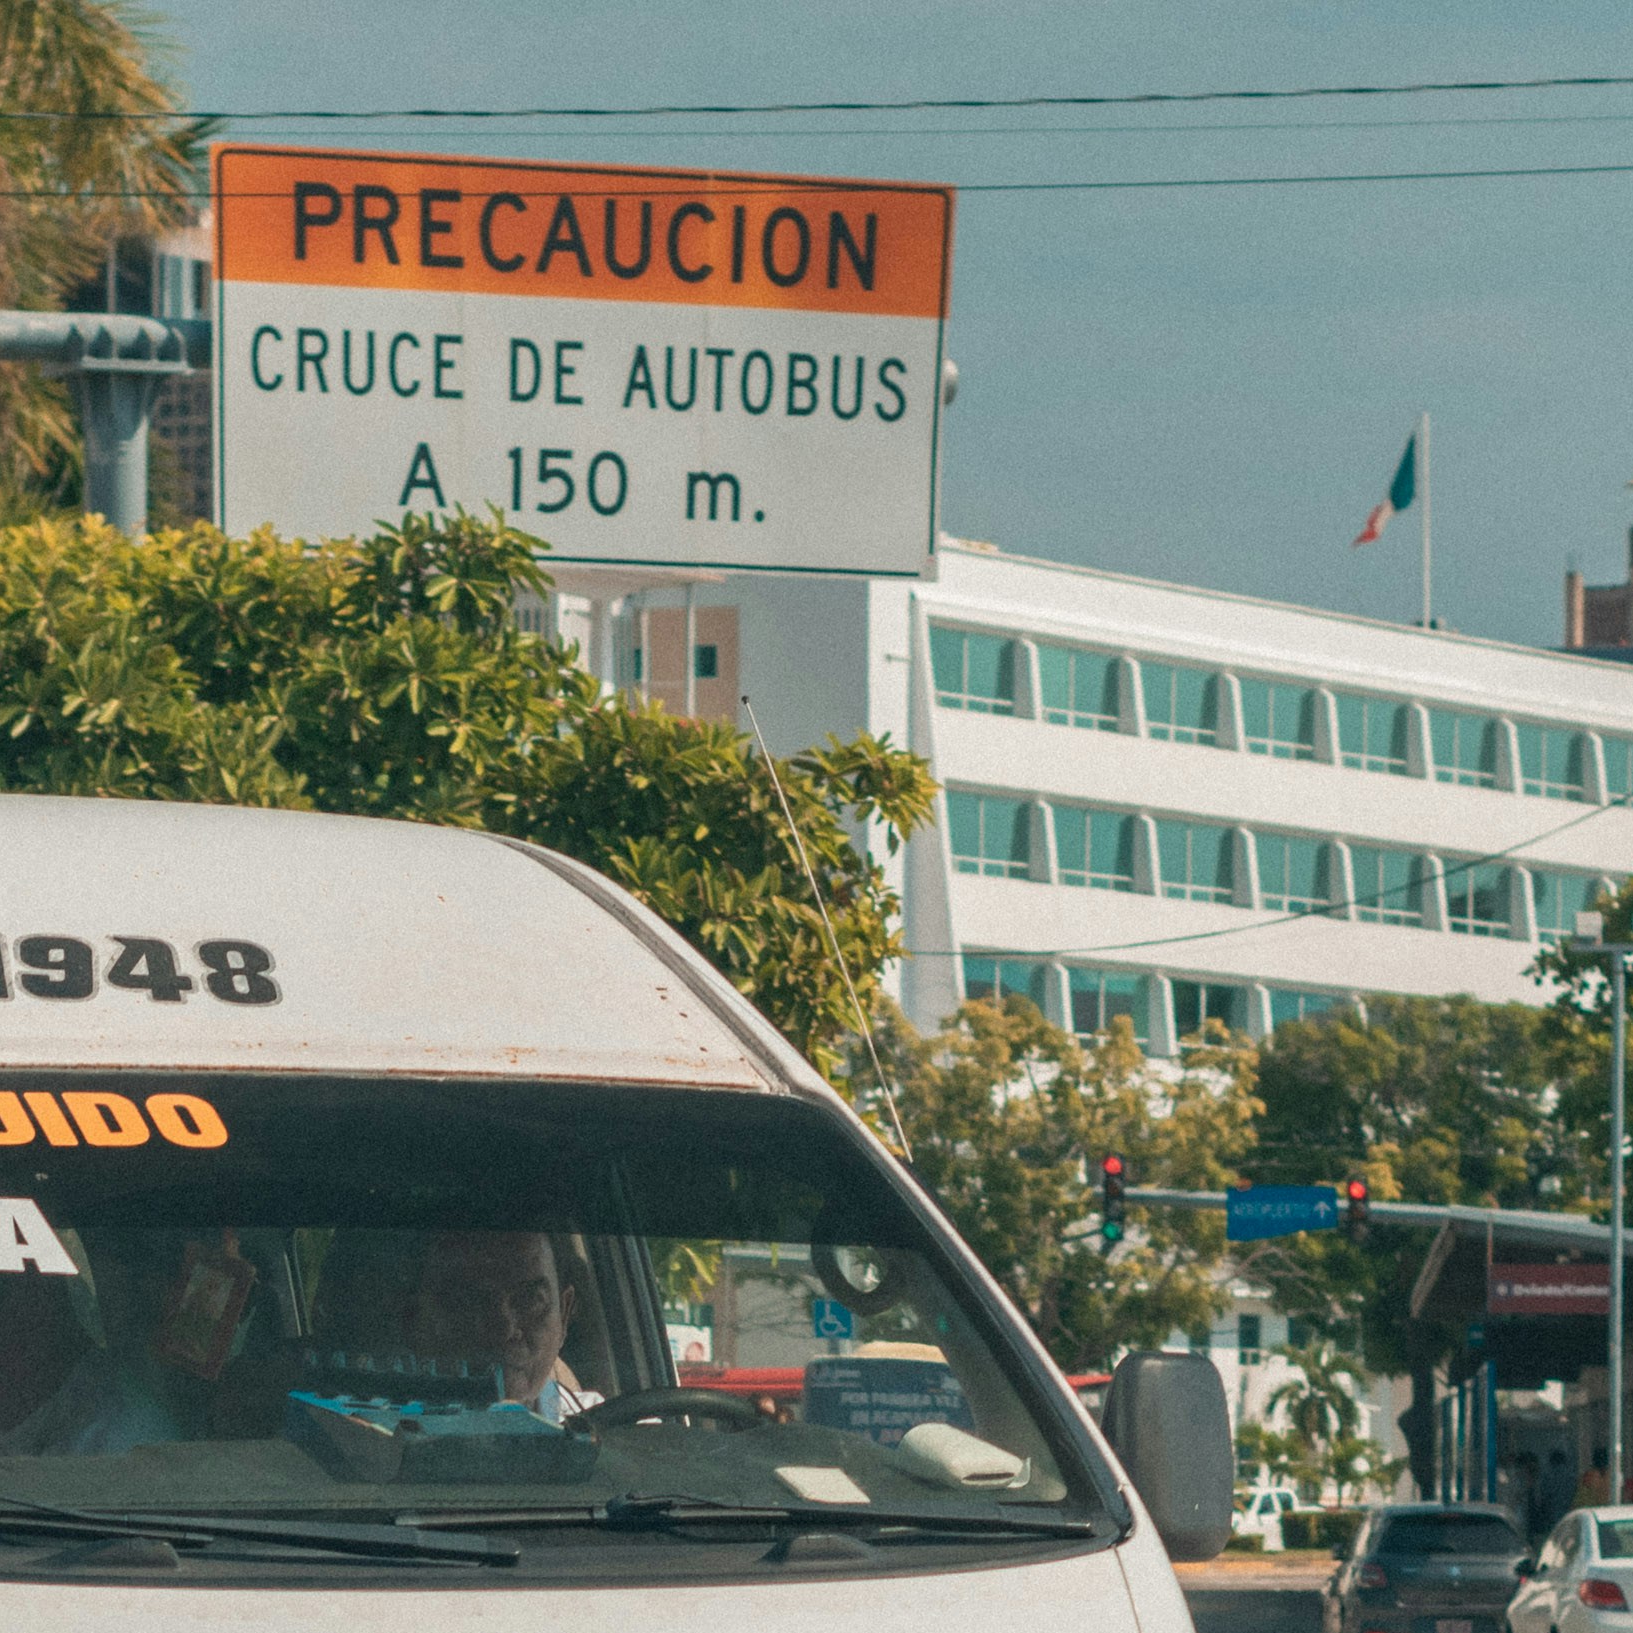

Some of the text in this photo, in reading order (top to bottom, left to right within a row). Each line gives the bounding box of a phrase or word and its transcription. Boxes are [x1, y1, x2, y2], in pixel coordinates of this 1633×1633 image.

[293, 182, 877, 291] PRECAUCION
[250, 325, 908, 422] CRUCE DE AUTOBUS
[398, 442, 767, 522] A 150 m.
